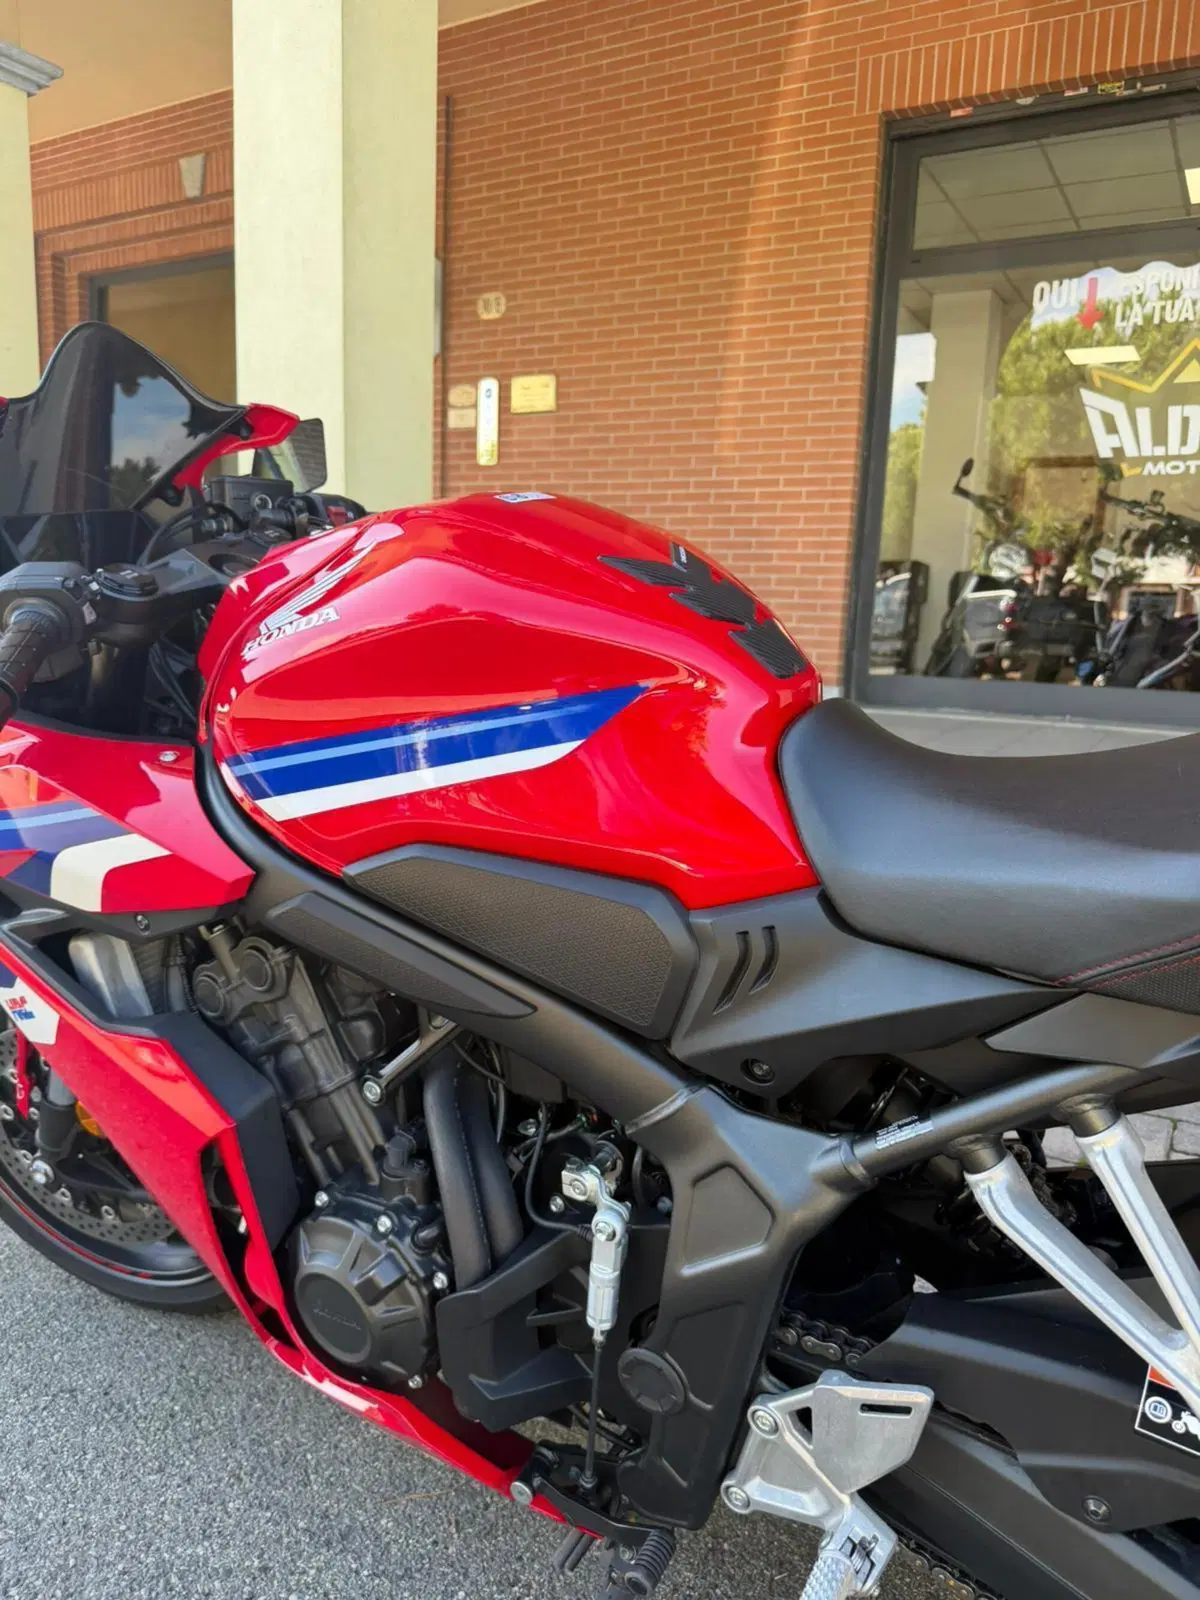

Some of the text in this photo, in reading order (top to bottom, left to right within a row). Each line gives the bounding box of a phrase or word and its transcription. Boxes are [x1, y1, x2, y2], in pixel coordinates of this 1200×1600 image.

[1033, 278, 1079, 313] QUI
[1115, 297, 1195, 328] LA TUA
[241, 606, 340, 656] HONDA
